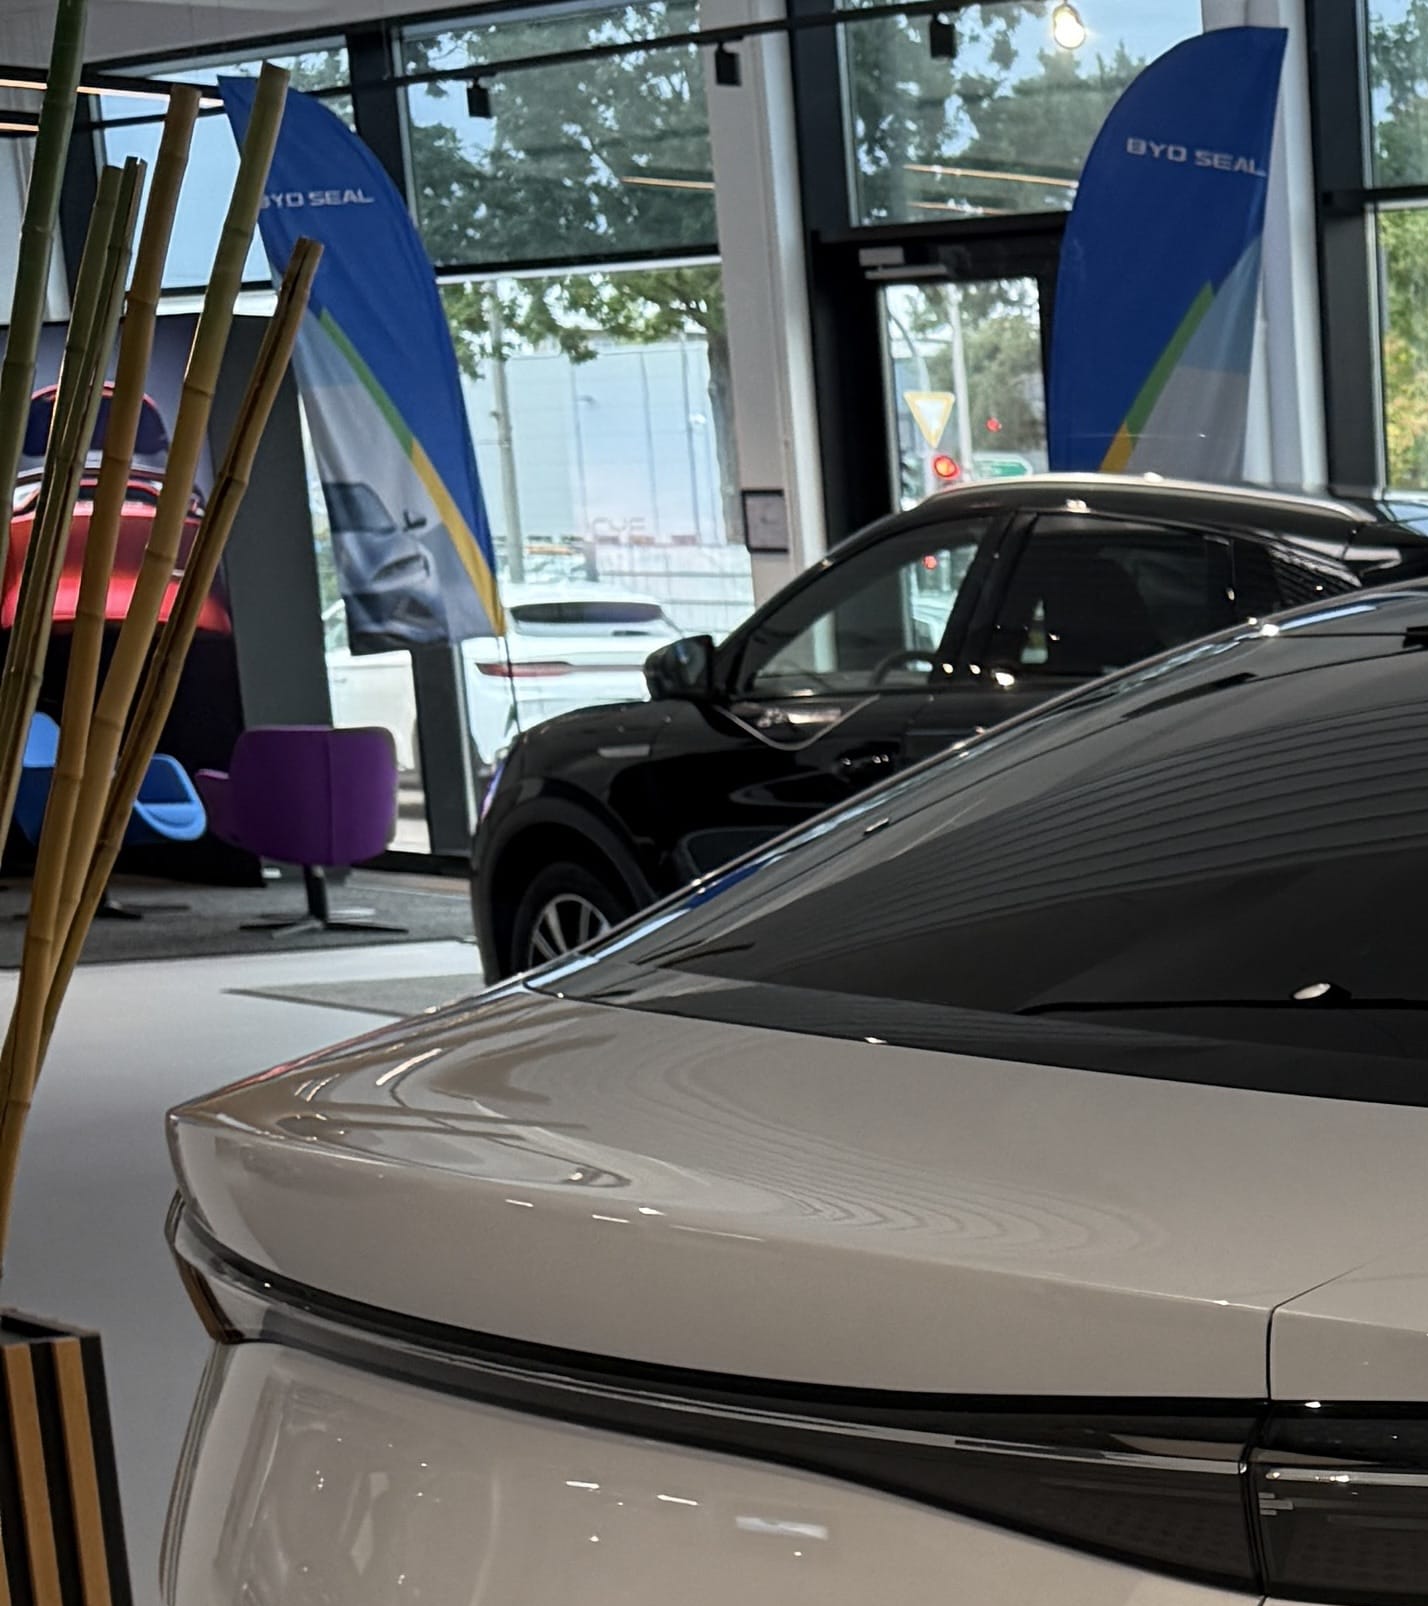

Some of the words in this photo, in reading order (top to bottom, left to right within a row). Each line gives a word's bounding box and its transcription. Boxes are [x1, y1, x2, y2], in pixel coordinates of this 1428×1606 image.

[1126, 137, 1187, 162] BYD
[1195, 149, 1267, 177] SEAL
[309, 189, 375, 206] SEAL
